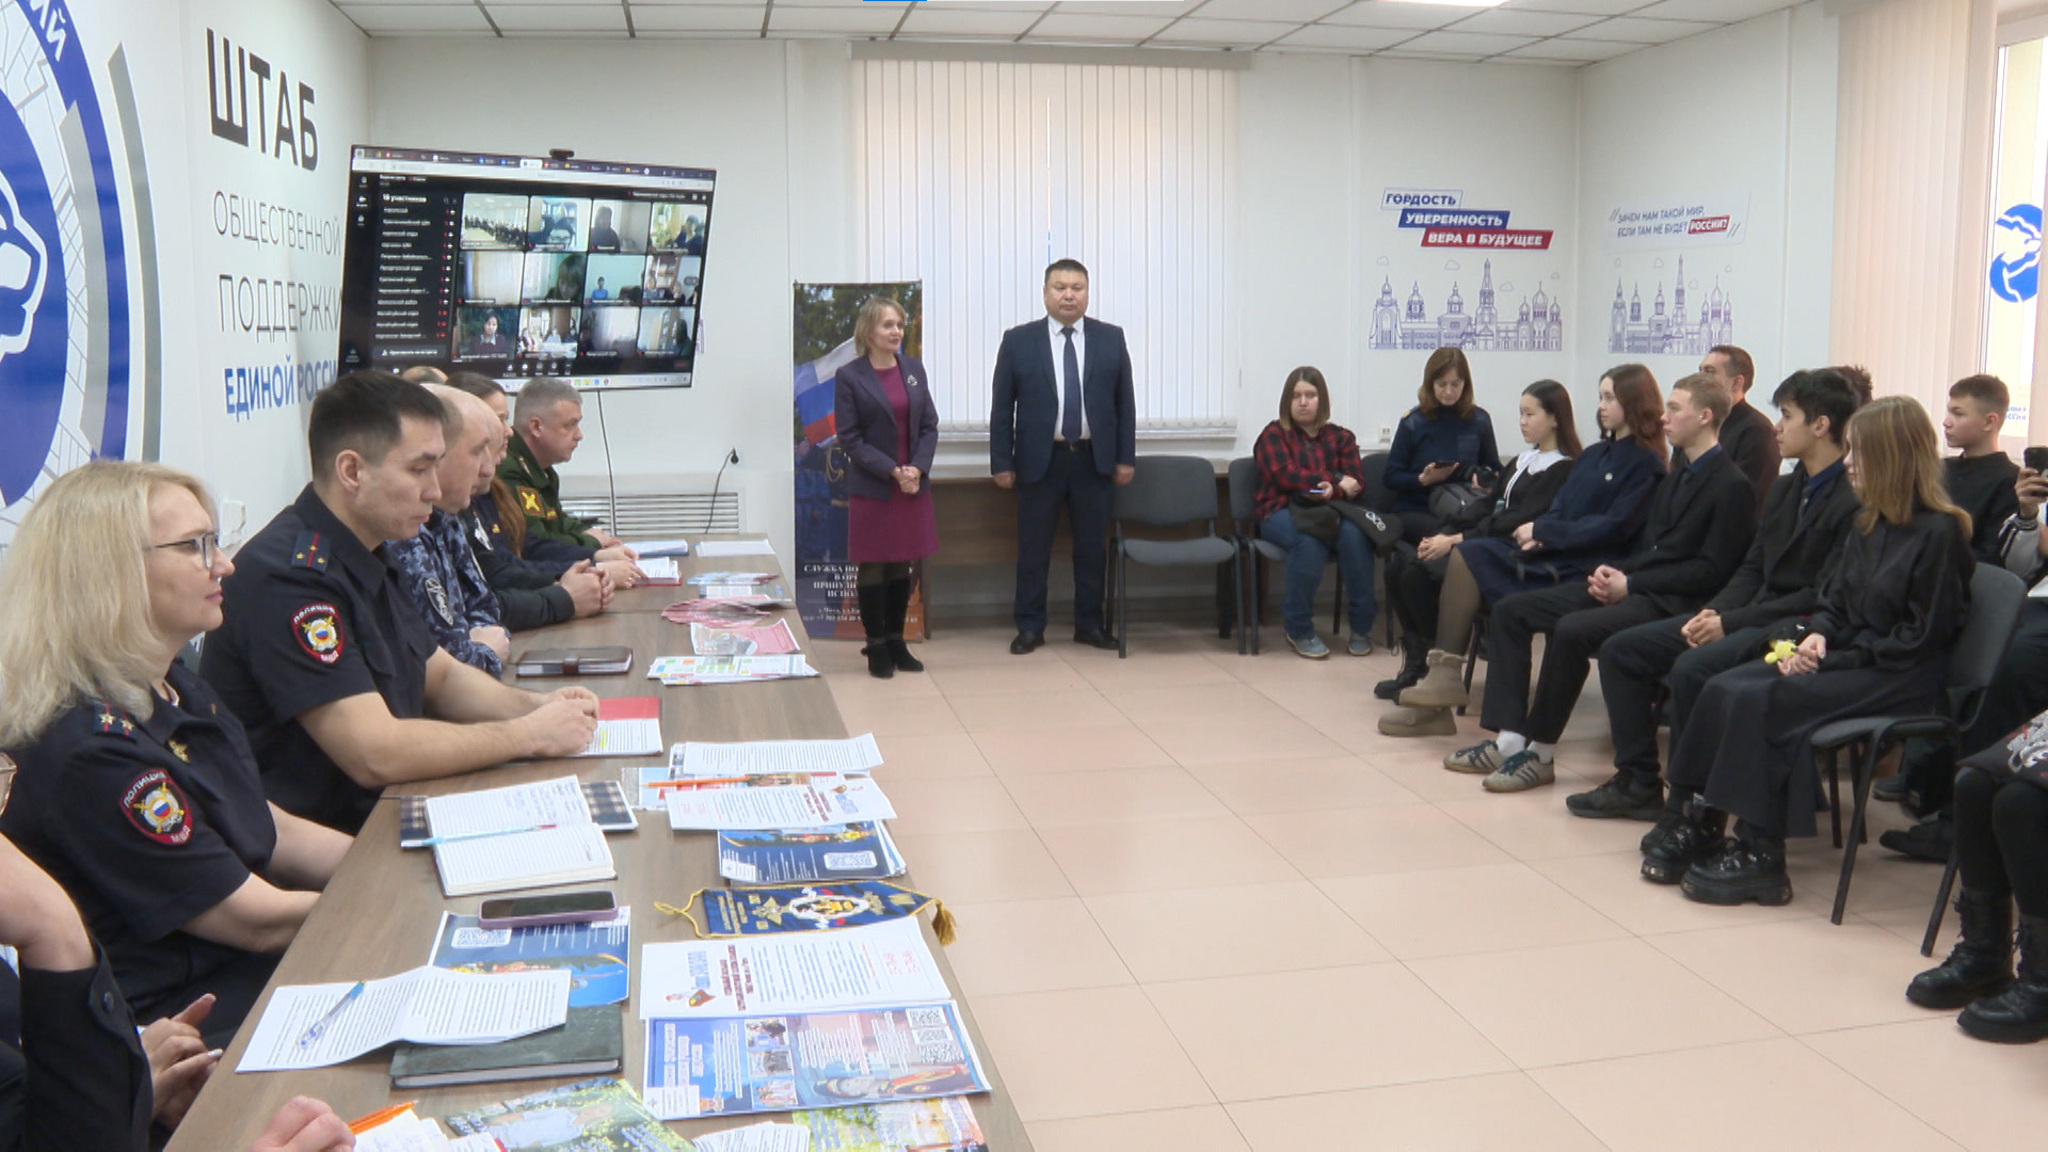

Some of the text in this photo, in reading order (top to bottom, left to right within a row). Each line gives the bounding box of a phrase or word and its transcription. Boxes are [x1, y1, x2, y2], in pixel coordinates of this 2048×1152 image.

[206, 27, 318, 171] ШТАБ
[1386, 193, 1456, 206] ГОРДОСТЬ
[213, 190, 341, 256] ОБЩЕСТВЕННОЙ
[1405, 212, 1503, 226] УВЕРЕННОСТЬ
[1618, 206, 1705, 224] ЗАЧЕМ НАМ ТАКОЙ МИР,
[1617, 218, 1727, 238] ЕСЛИ ТАМ НЕ БУДЕТ РОССИИ?
[1428, 231, 1544, 247] ВЕРА В БУДУЩЕЕ
[224, 354, 337, 420] ЕДИНОЙ РОССИ
[803, 564, 843, 572] СЛУЖБА
[293, 604, 335, 624] ПОЛИЦИЯ
[123, 771, 167, 808] ПОЛИЦИЯ
[171, 825, 191, 843] МВД
